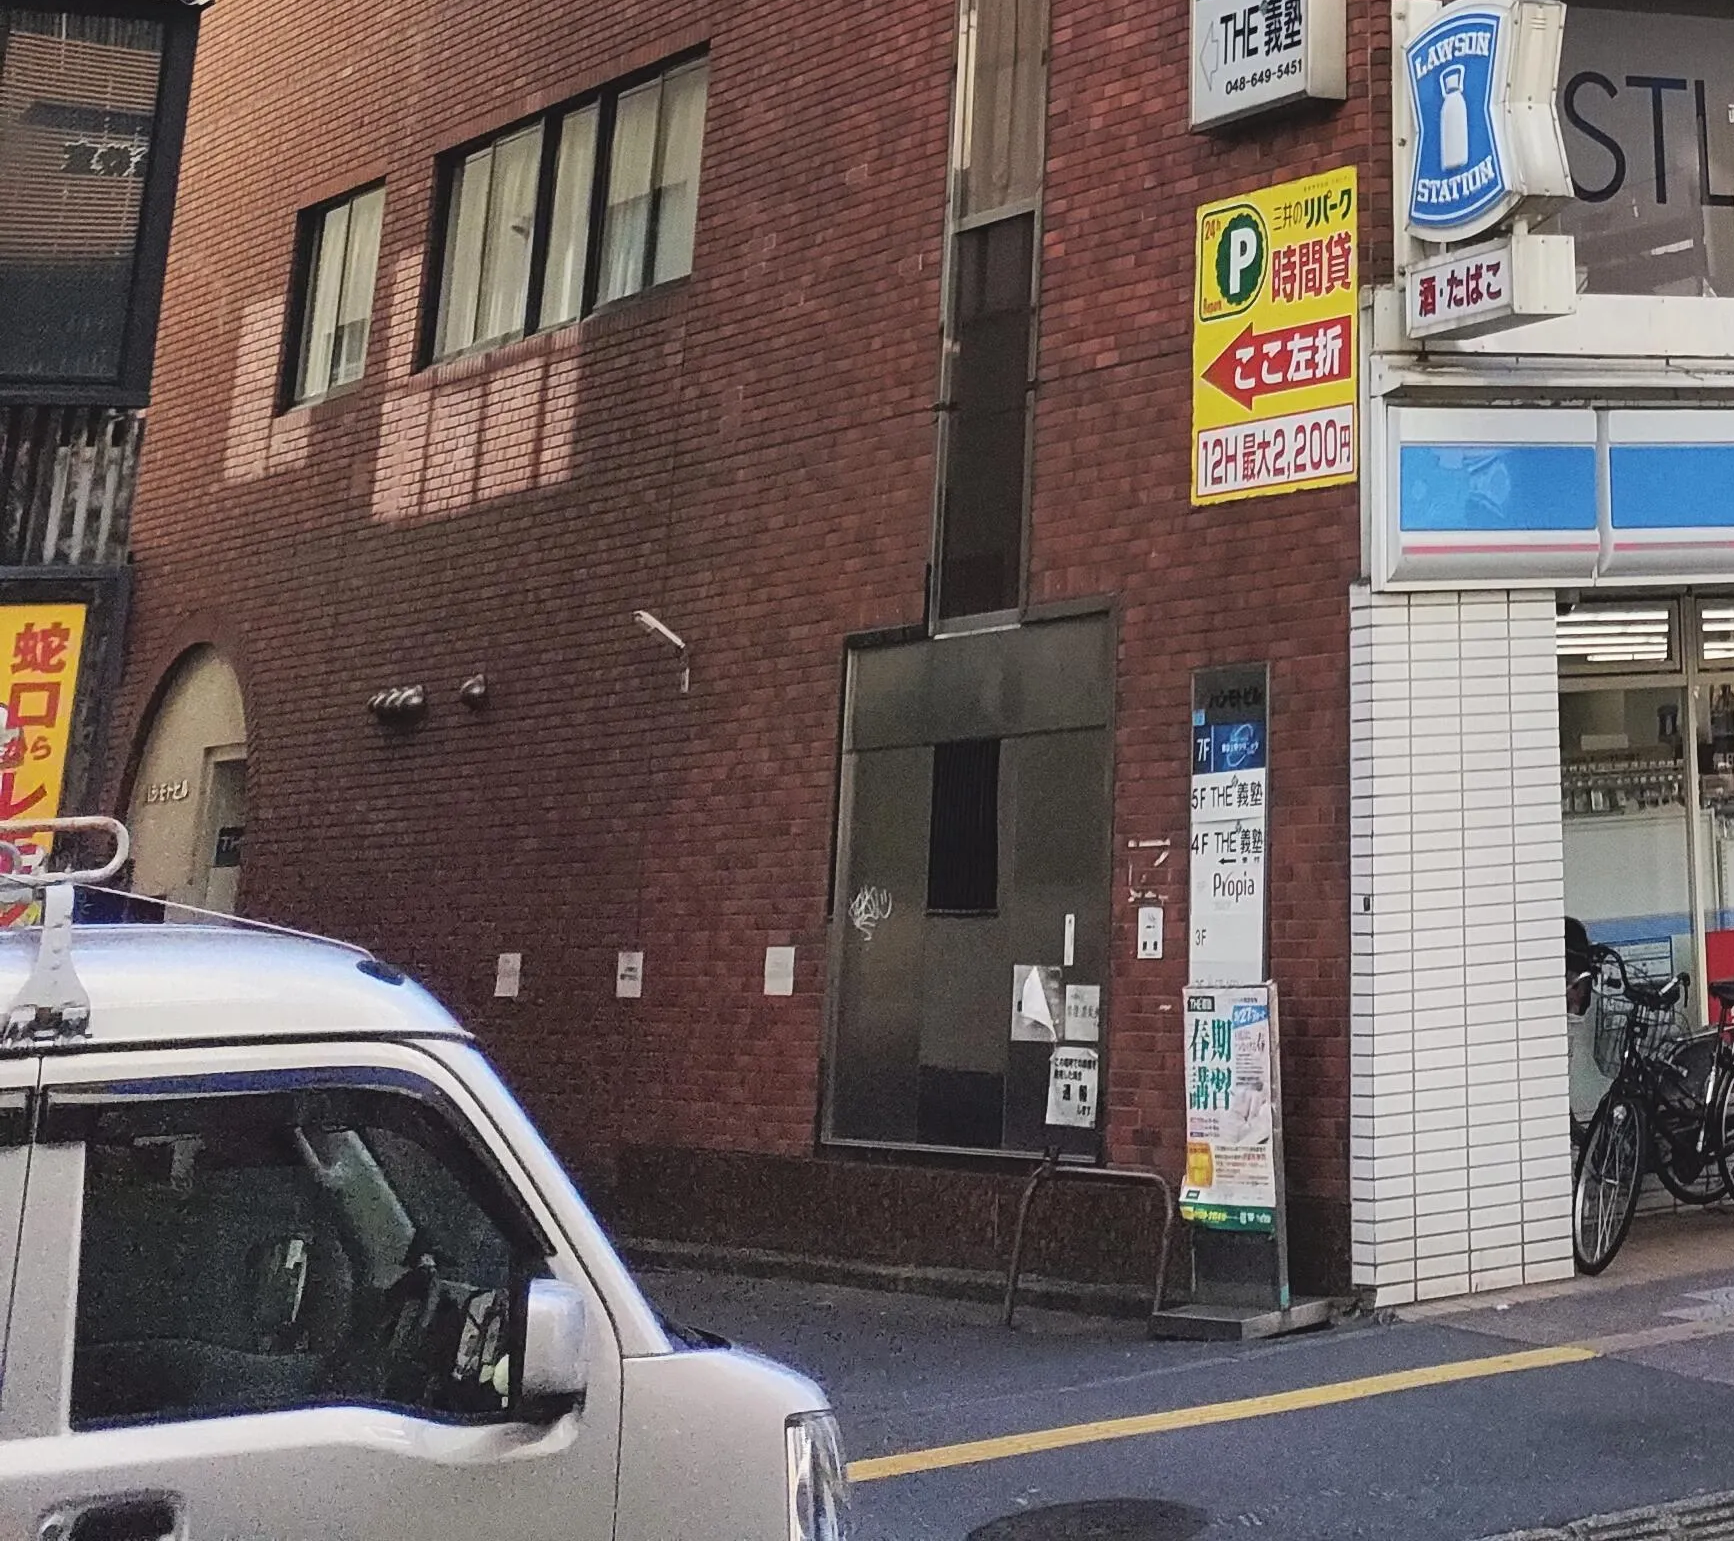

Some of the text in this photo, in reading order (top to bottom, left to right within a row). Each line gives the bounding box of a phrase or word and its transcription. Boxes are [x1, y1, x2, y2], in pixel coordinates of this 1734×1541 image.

[1220, 9, 1257, 66] THE
[1415, 31, 1491, 77] LAWSON
[1225, 58, 1302, 96] 048-649-5451
[1416, 167, 1495, 204] STATION
[1272, 188, 1352, 232] 三井のリパーク
[1271, 231, 1352, 303] 時間貸
[1418, 262, 1503, 318] 酒・たばこ
[1233, 325, 1343, 390] ここ左折
[1202, 417, 1353, 489] 12H 最大2,200円
[1196, 738, 1211, 761] 7F
[1191, 780, 1263, 809] 5F THE 義塾
[1191, 828, 1263, 856] 4F THE 義塾
[1213, 871, 1255, 903] Propia
[1195, 929, 1207, 946] 3F
